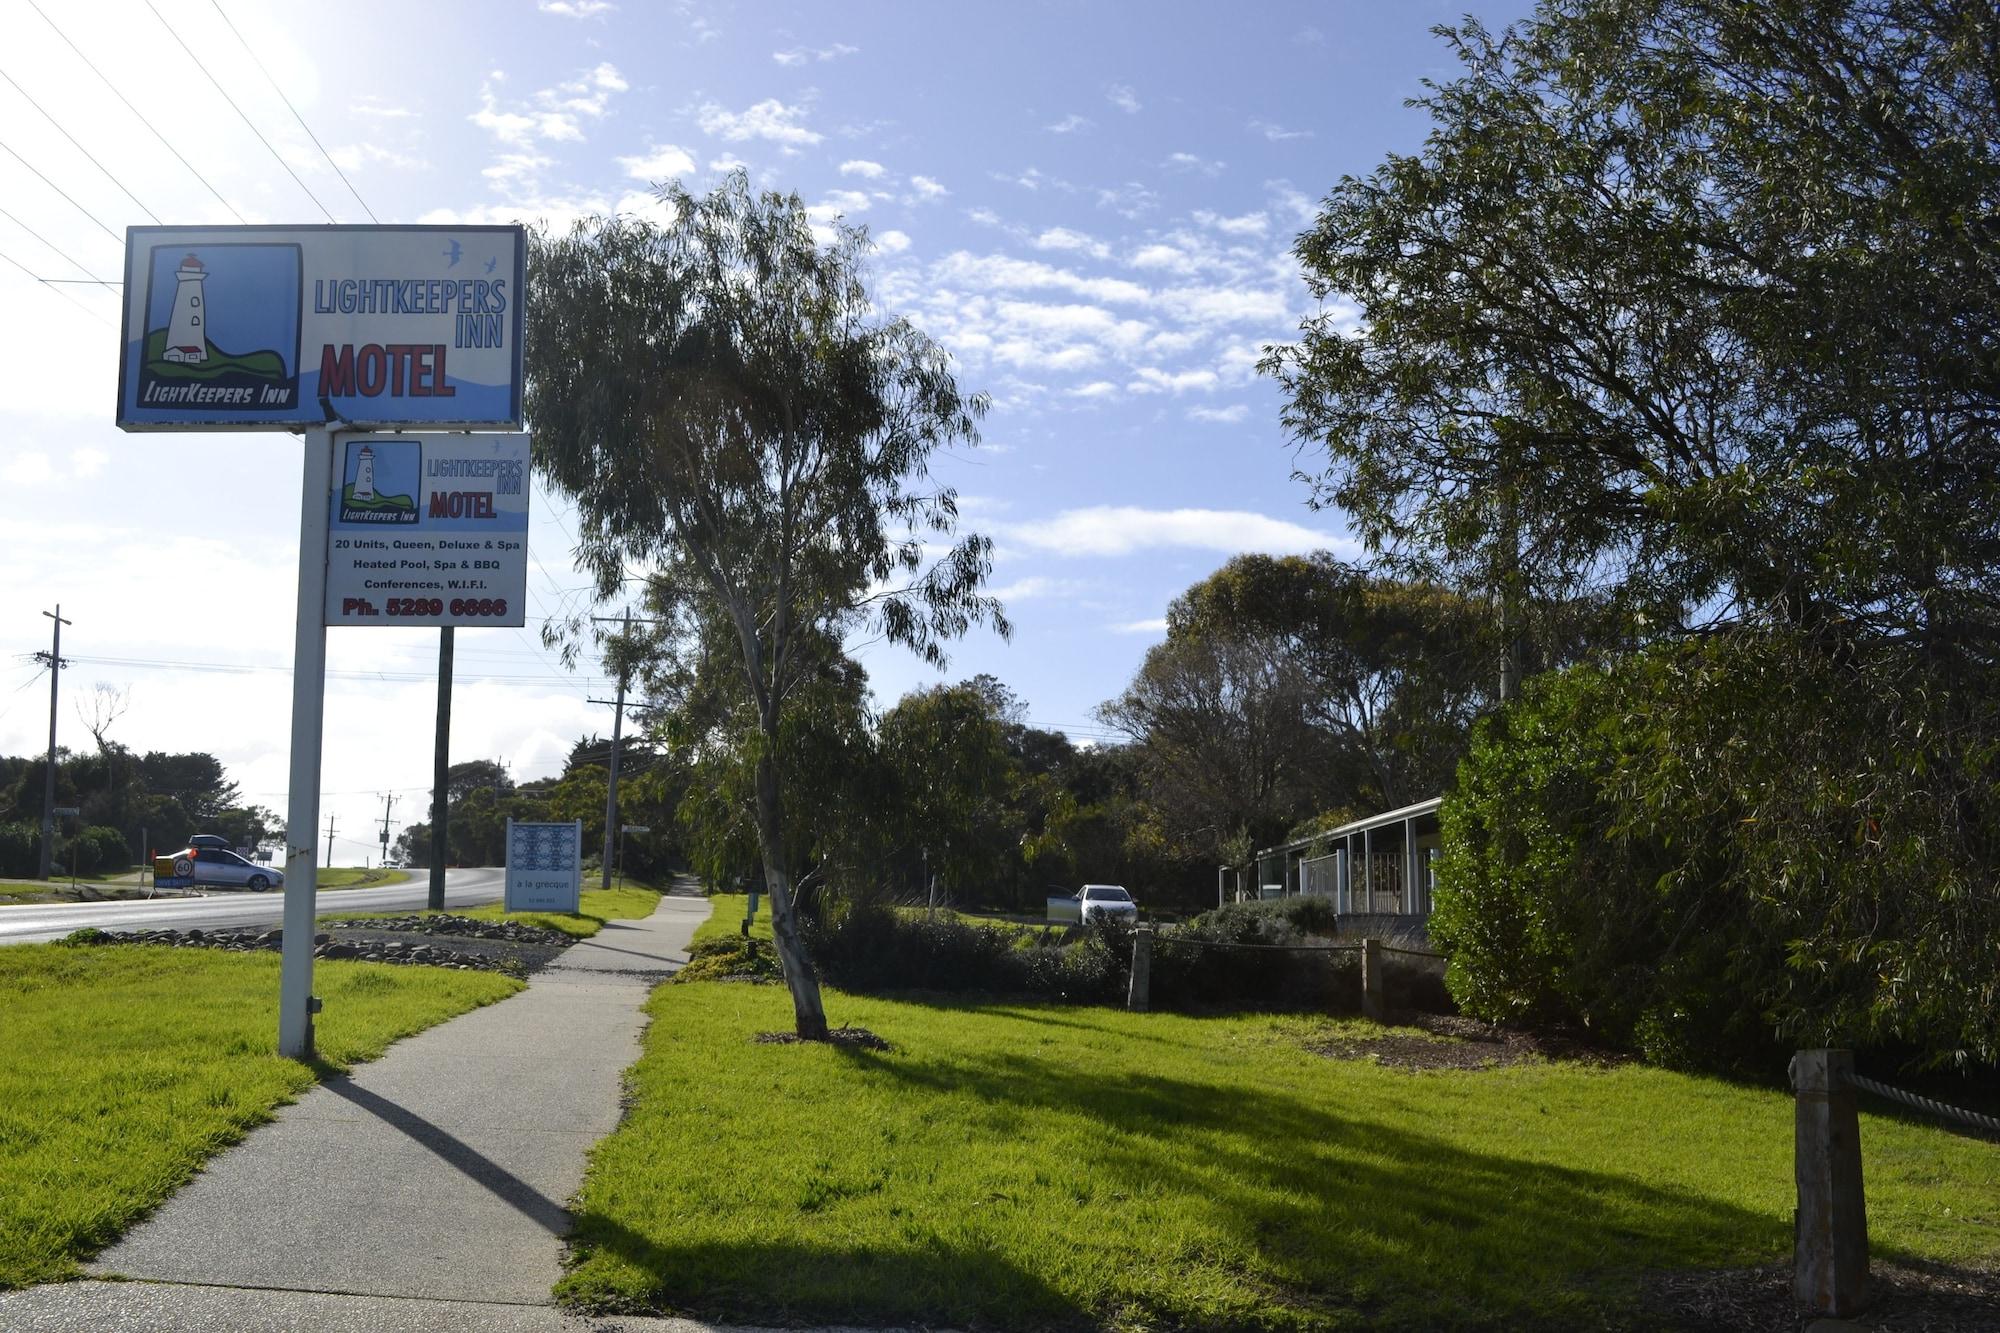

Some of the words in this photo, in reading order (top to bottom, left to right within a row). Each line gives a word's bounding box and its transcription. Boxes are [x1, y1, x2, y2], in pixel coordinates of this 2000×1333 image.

[314, 279, 507, 314] LIGHTKEEPERS
[455, 314, 503, 348] INN
[319, 344, 455, 397] MOTEL
[427, 459, 522, 477] LIGHTKEEPERS
[497, 477, 521, 495] INN
[428, 491, 497, 518] MOTEL
[335, 540, 350, 549] 20
[354, 540, 389, 551] Units,
[393, 540, 435, 551] Queen,
[439, 541, 480, 549] Deluxe
[484, 541, 493, 550] &
[497, 541, 520, 552] Spa
[353, 560, 396, 569] Heated
[400, 560, 430, 570] Pool,
[433, 561, 456, 571] Spa
[460, 561, 469, 569] &
[474, 561, 500, 570] BBQ
[364, 580, 444, 590] Conferences,
[448, 580, 487, 589] W.I.F.I.
[342, 598, 379, 616] Ph.
[385, 599, 444, 616] 5289
[178, 863, 189, 872] 60
